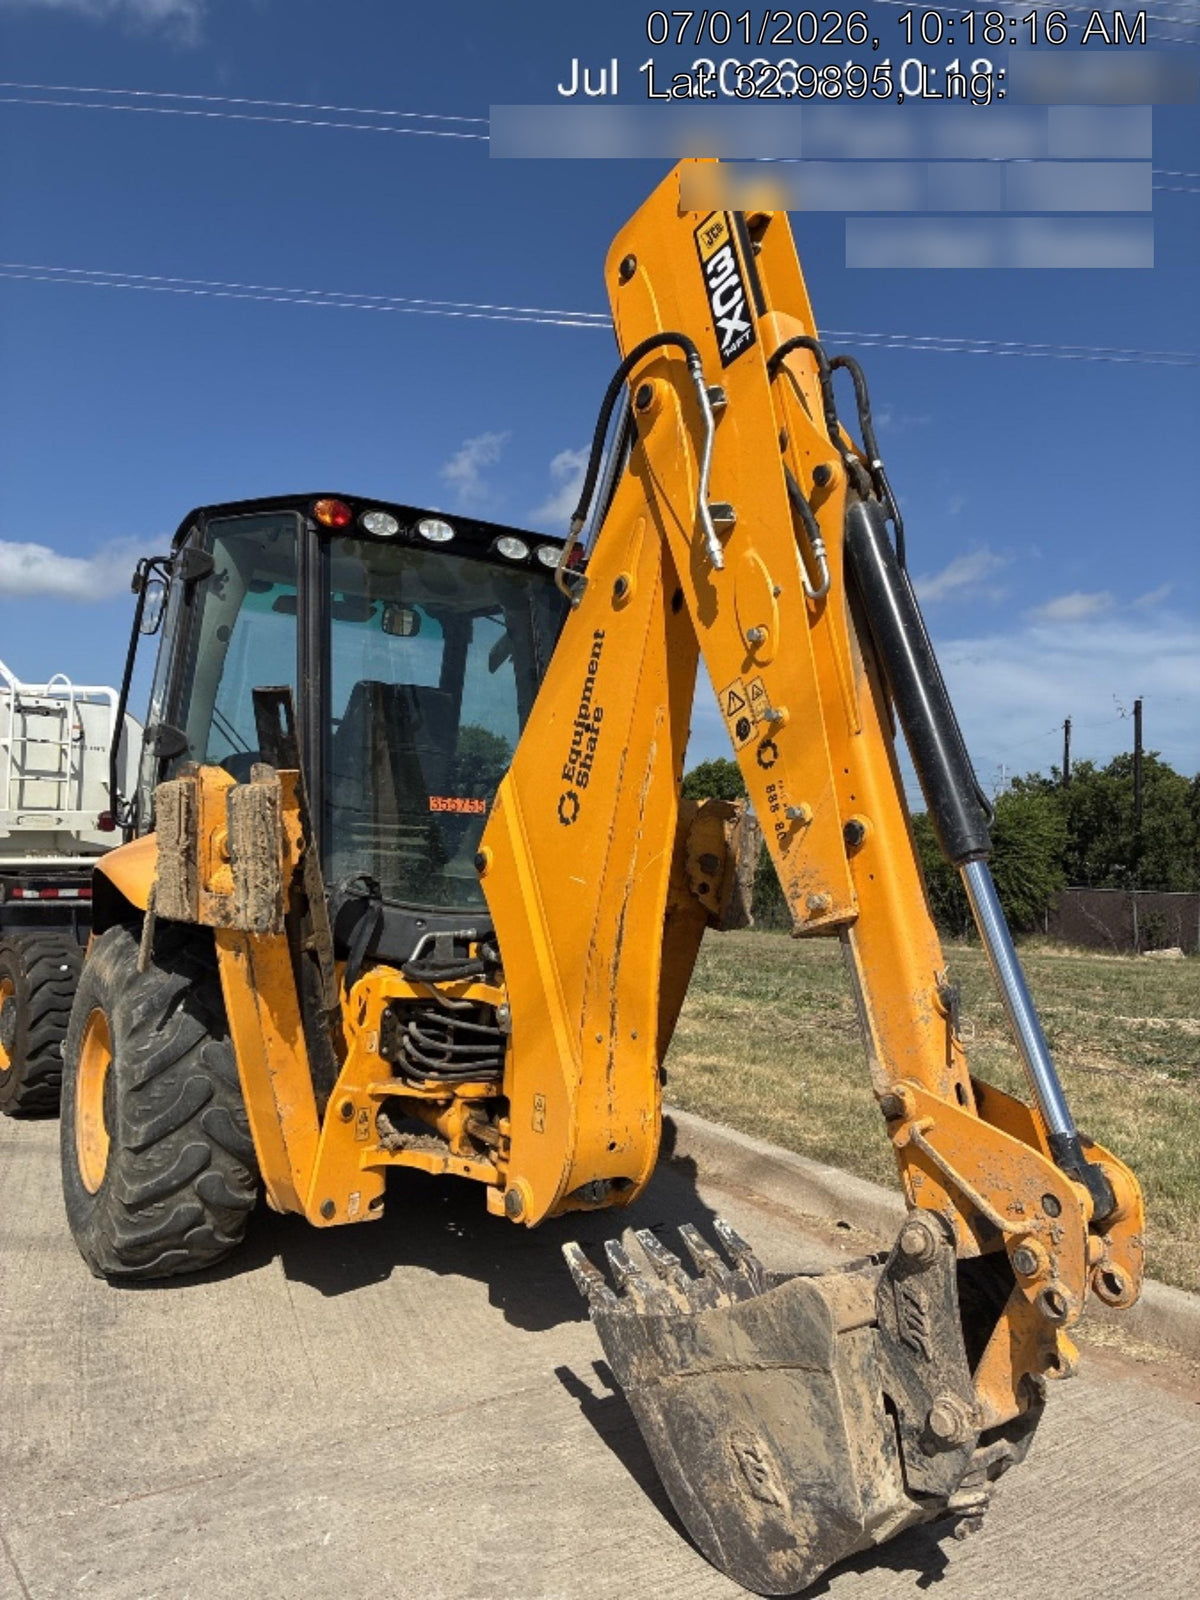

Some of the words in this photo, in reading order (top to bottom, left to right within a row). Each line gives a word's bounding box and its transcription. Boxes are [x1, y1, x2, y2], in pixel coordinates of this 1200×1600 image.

[706, 245, 751, 350] 3CX
[561, 628, 605, 784] Equipment
[575, 706, 604, 791] Share
